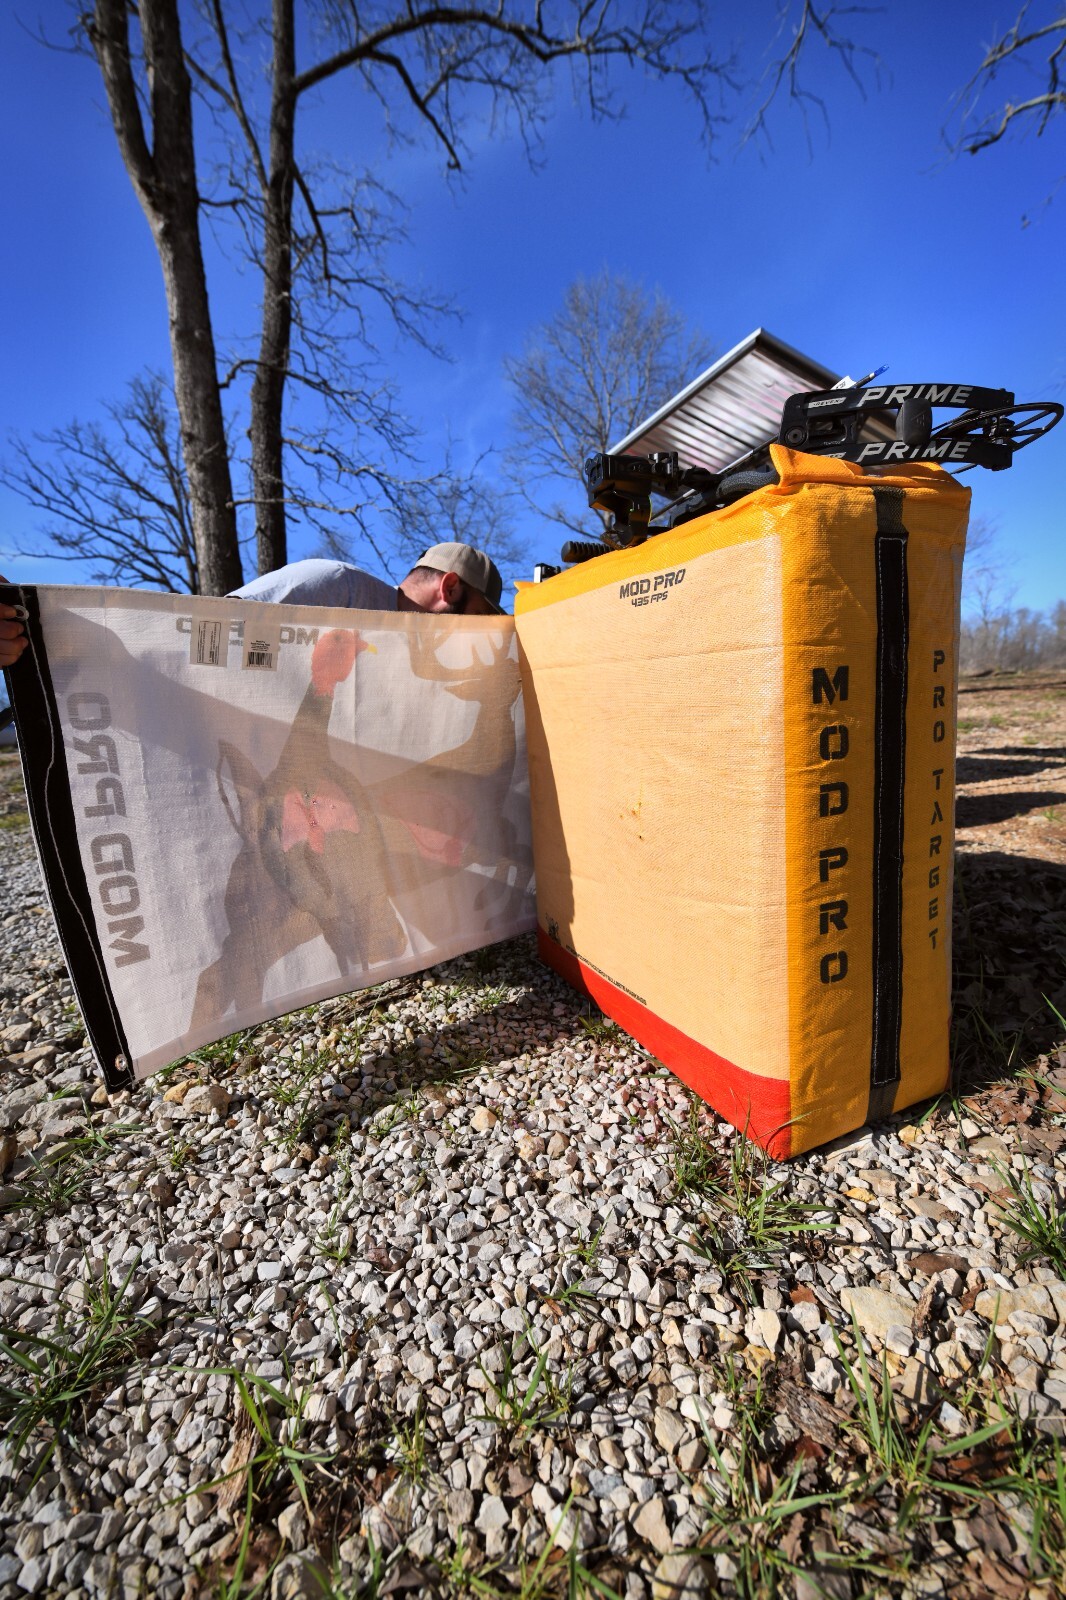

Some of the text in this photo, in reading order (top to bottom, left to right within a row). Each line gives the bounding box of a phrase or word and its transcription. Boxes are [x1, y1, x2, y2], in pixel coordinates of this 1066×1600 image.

[858, 385, 975, 407] PRIME
[856, 441, 971, 463] PRIME
[619, 568, 686, 599] MOD PRO
[631, 591, 668, 607] 435 FPS
[928, 650, 945, 950] PRO TARGET
[812, 665, 849, 984] MOD PRO
